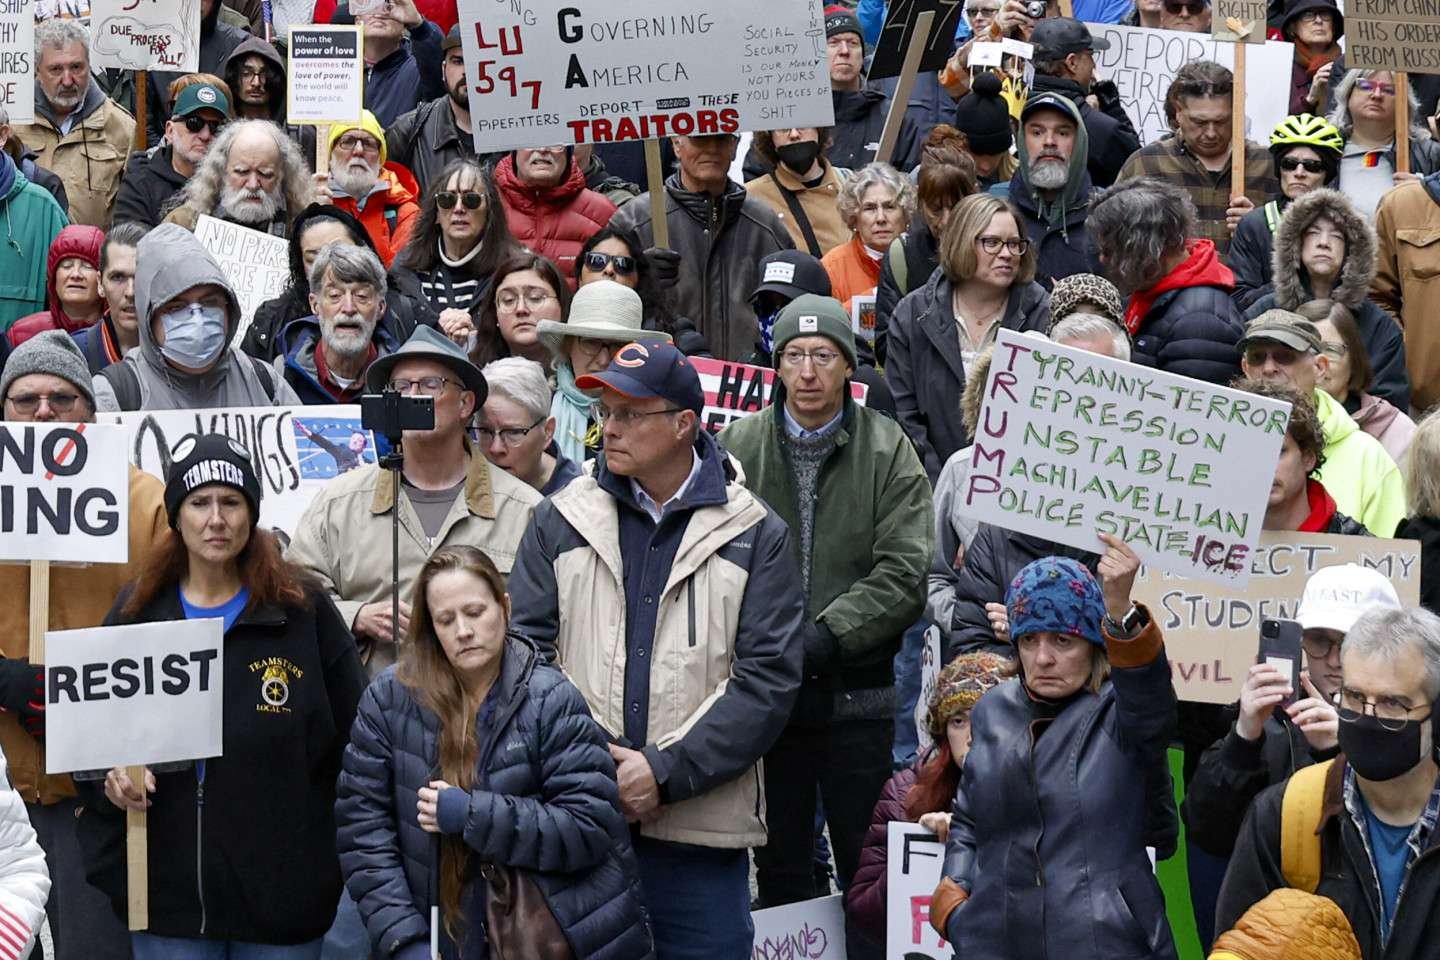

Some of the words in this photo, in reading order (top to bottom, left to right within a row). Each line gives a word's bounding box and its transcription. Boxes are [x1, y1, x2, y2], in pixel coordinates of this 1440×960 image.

[1217, 0, 1266, 20] RIGHTS
[110, 23, 132, 37] DUE
[558, 7, 715, 44] GOVERNING
[1358, 20, 1390, 42] HIS
[130, 32, 171, 47] PROCESS
[149, 43, 167, 56] FOR
[295, 35, 318, 43] When
[319, 35, 332, 43] the
[295, 48, 322, 56] power
[324, 46, 333, 55] of
[335, 46, 354, 55] love
[744, 44, 798, 57] SECURITY
[1352, 45, 1397, 66] FROM
[564, 53, 689, 90] AMERICA
[748, 75, 772, 86] NOT
[778, 71, 815, 84] YOURS
[475, 59, 543, 110] 597
[579, 99, 644, 117] DEPORT
[698, 93, 739, 106] THESE
[760, 104, 797, 119] SHIT
[567, 108, 740, 144] TRAITORS
[182, 459, 244, 491] TEAMSTERS
[1363, 550, 1417, 576] MY
[48, 649, 218, 705] RESIST
[249, 657, 303, 678] TEAMSTERS
